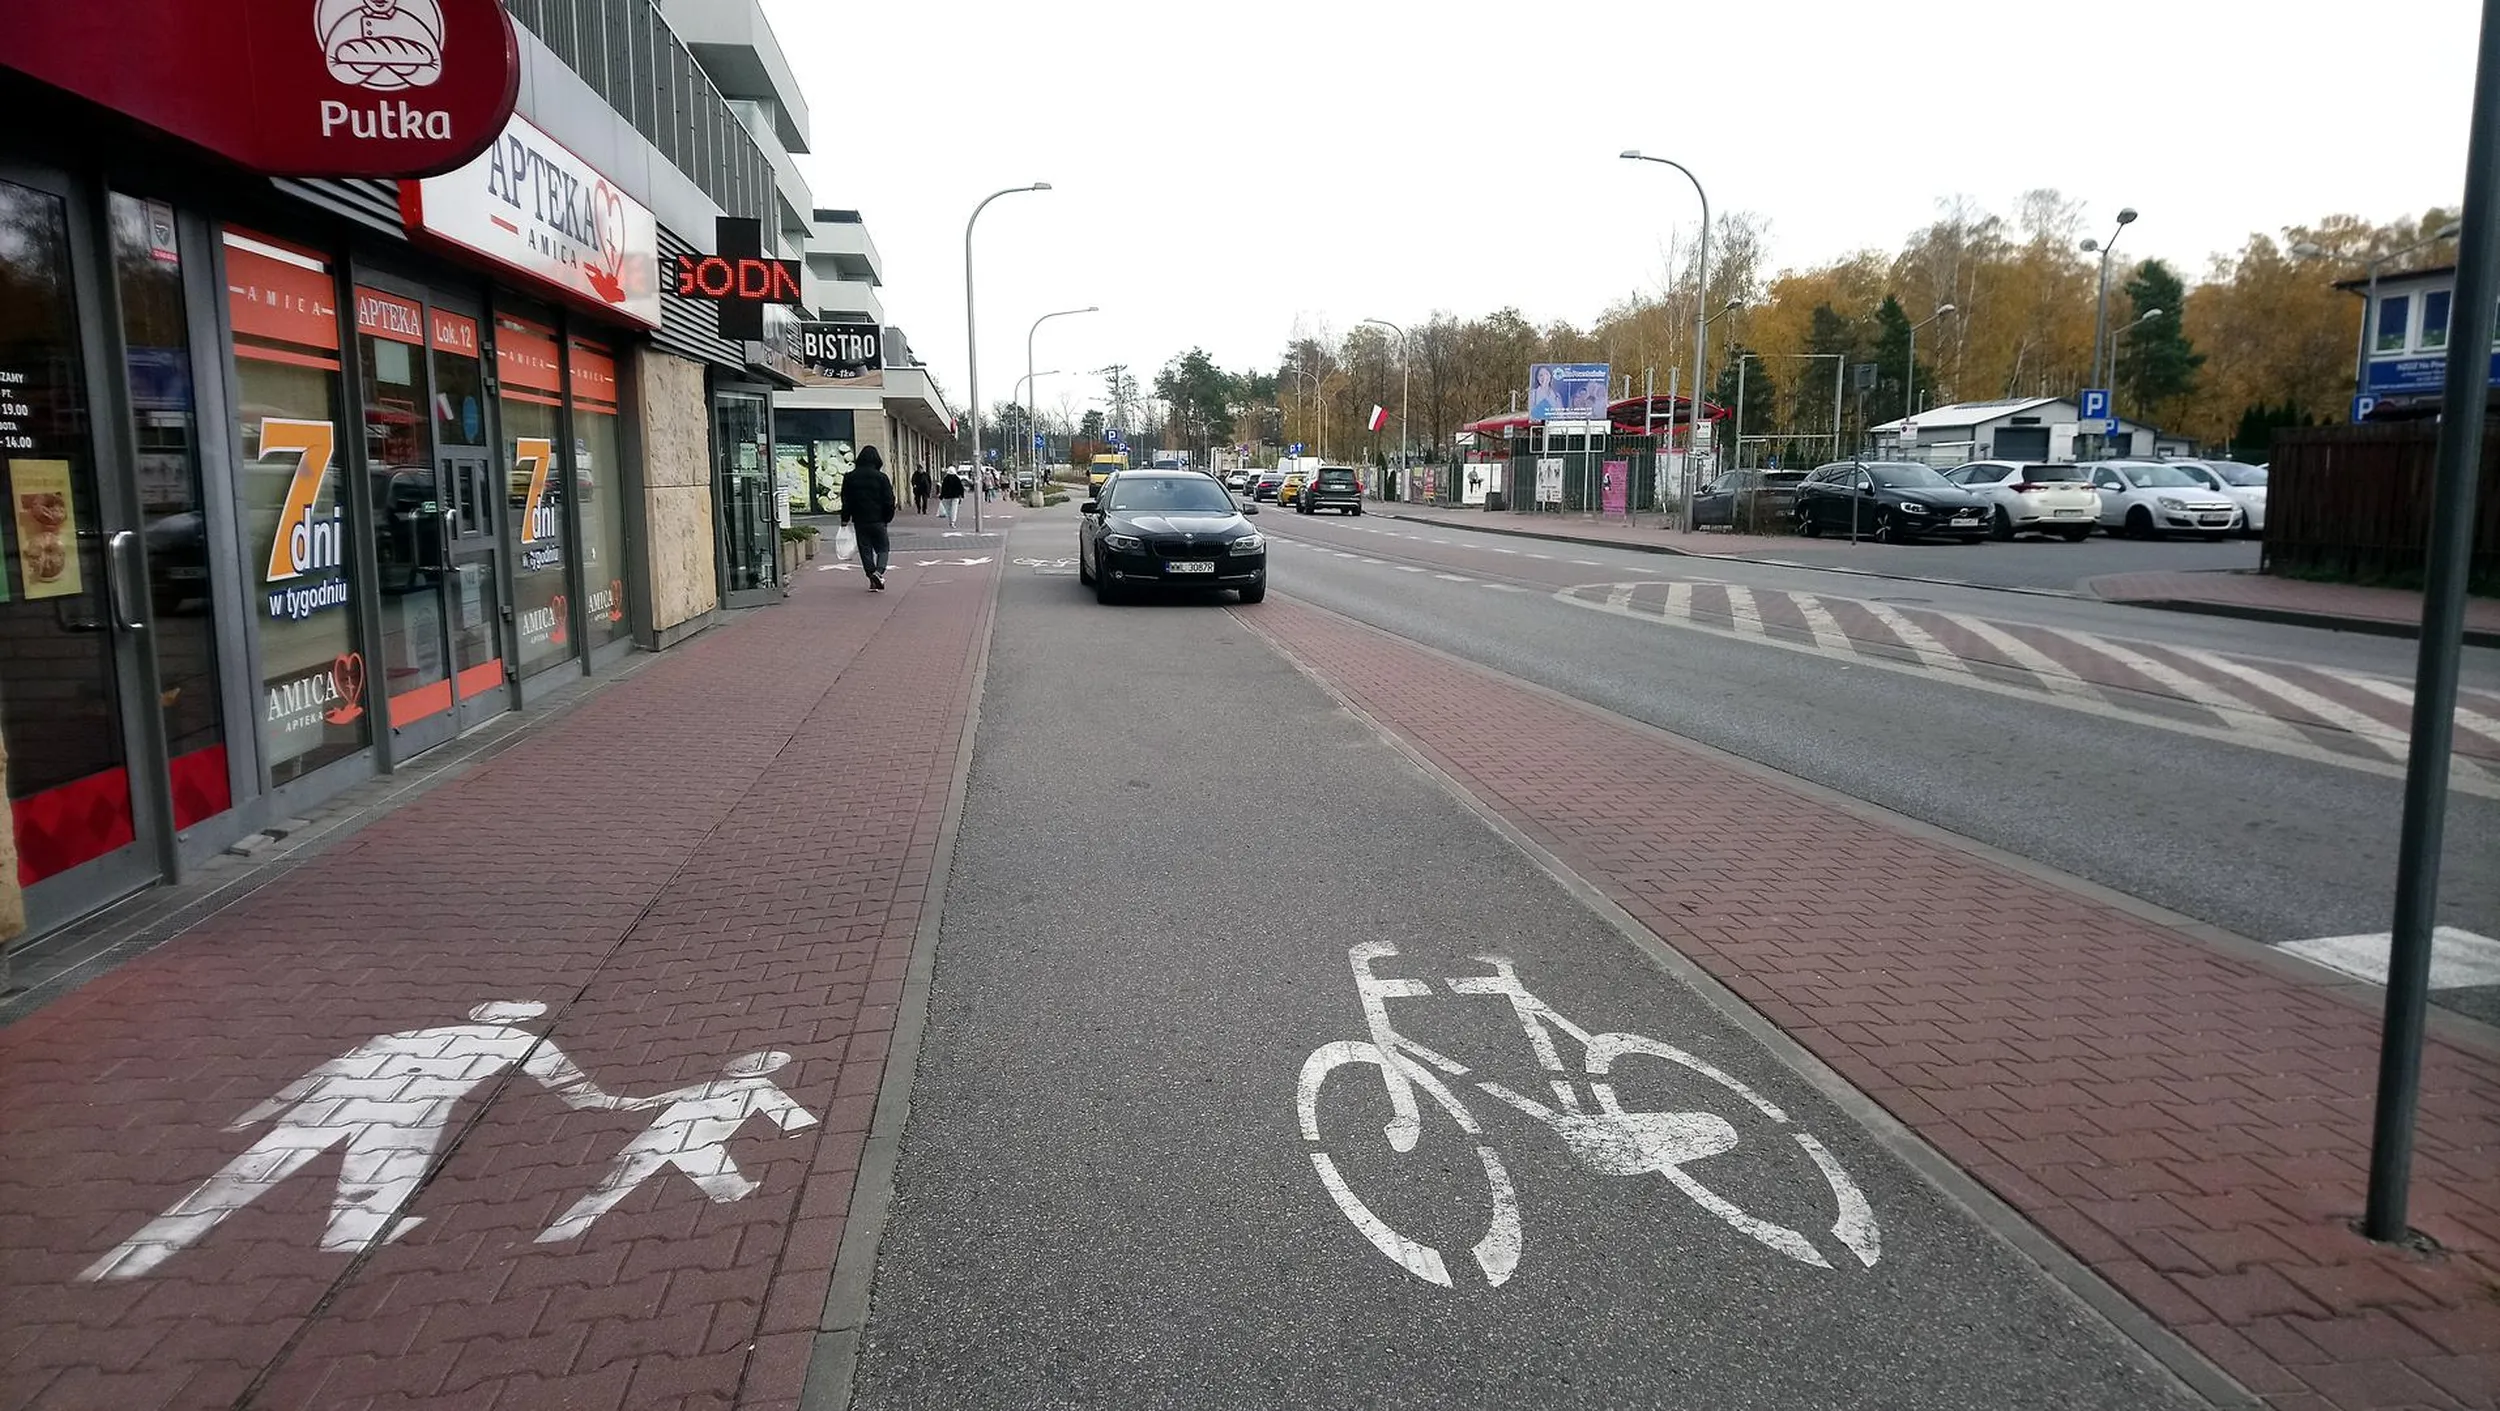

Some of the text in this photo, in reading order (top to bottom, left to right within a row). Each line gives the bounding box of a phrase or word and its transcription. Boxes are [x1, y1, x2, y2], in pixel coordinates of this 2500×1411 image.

[320, 100, 451, 140] Putka
[488, 133, 598, 251] APTEKA
[528, 228, 578, 269] AMICA
[247, 286, 321, 316] AMICA
[357, 296, 422, 337] APTEKA
[435, 317, 473, 348] Lok. 12
[804, 332, 875, 360] BISTRO
[0, 371, 24, 384] ZAMY
[1, 402, 29, 417] 19.00
[2086, 393, 2103, 416] P
[2358, 397, 2374, 420] P
[5, 435, 33, 449] 14.00
[258, 417, 342, 582] 7 dni
[515, 437, 555, 544] 7 dni
[268, 579, 347, 620] w tygodniu
[522, 606, 556, 635] AMICA
[267, 670, 339, 722] AMICA
[284, 710, 324, 733] APTEKA
